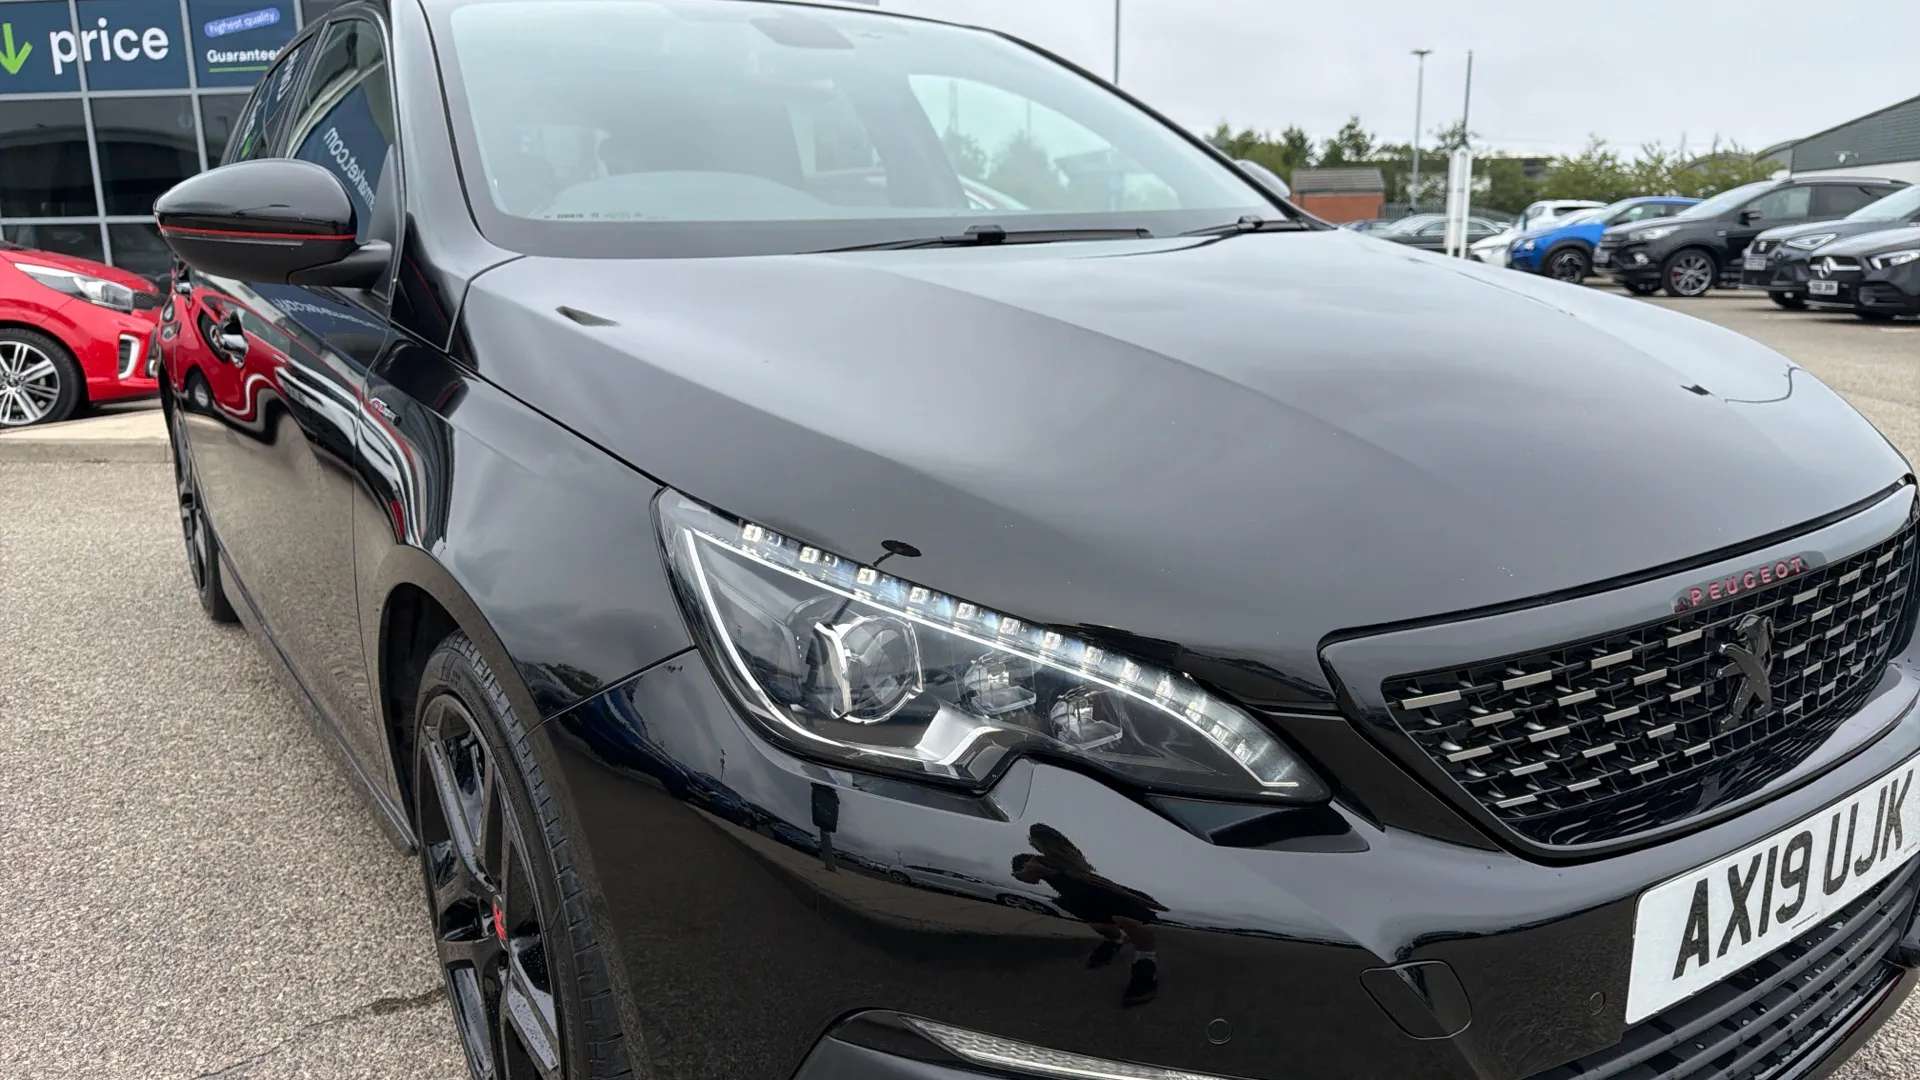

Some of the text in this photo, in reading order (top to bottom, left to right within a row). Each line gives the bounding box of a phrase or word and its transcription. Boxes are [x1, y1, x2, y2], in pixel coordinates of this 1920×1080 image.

[49, 17, 169, 75] price
[208, 18, 243, 36] highest
[206, 46, 285, 63] Guarantee
[1689, 555, 1804, 607] PEUGEOT
[1672, 768, 1914, 981] AX19 UJK
